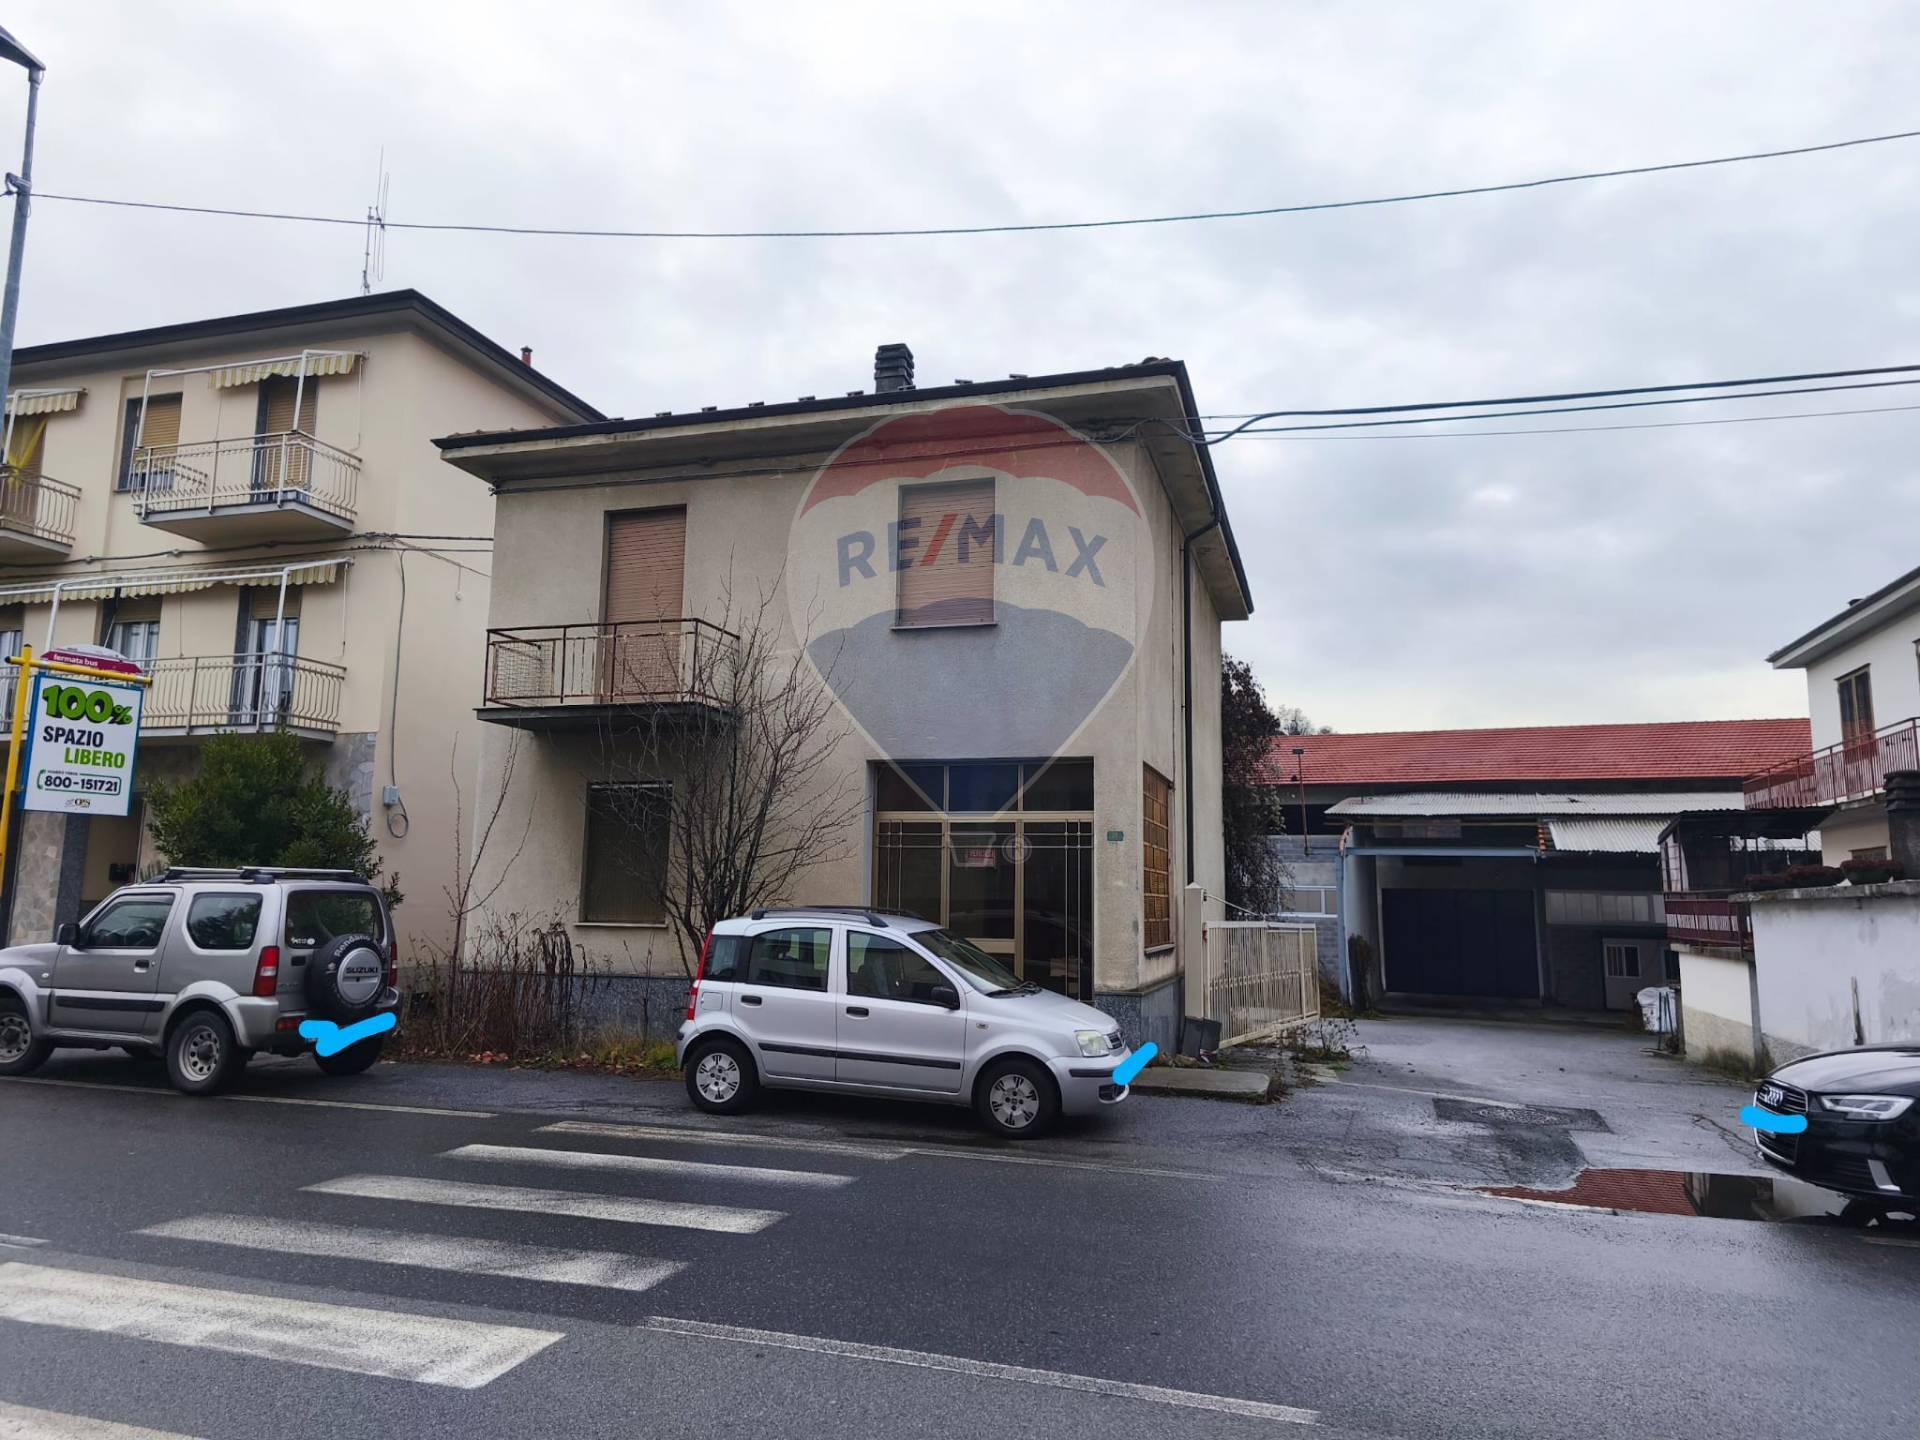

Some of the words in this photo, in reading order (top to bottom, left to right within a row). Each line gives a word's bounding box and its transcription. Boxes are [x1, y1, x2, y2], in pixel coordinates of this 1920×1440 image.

[53, 654, 83, 664] fermata
[84, 657, 98, 668] bus
[42, 684, 133, 725] 100%
[43, 725, 104, 748] SPAZIO
[64, 747, 126, 769] LIBERO
[44, 775, 118, 793] 800-151721
[346, 966, 378, 974] SUZUKI
